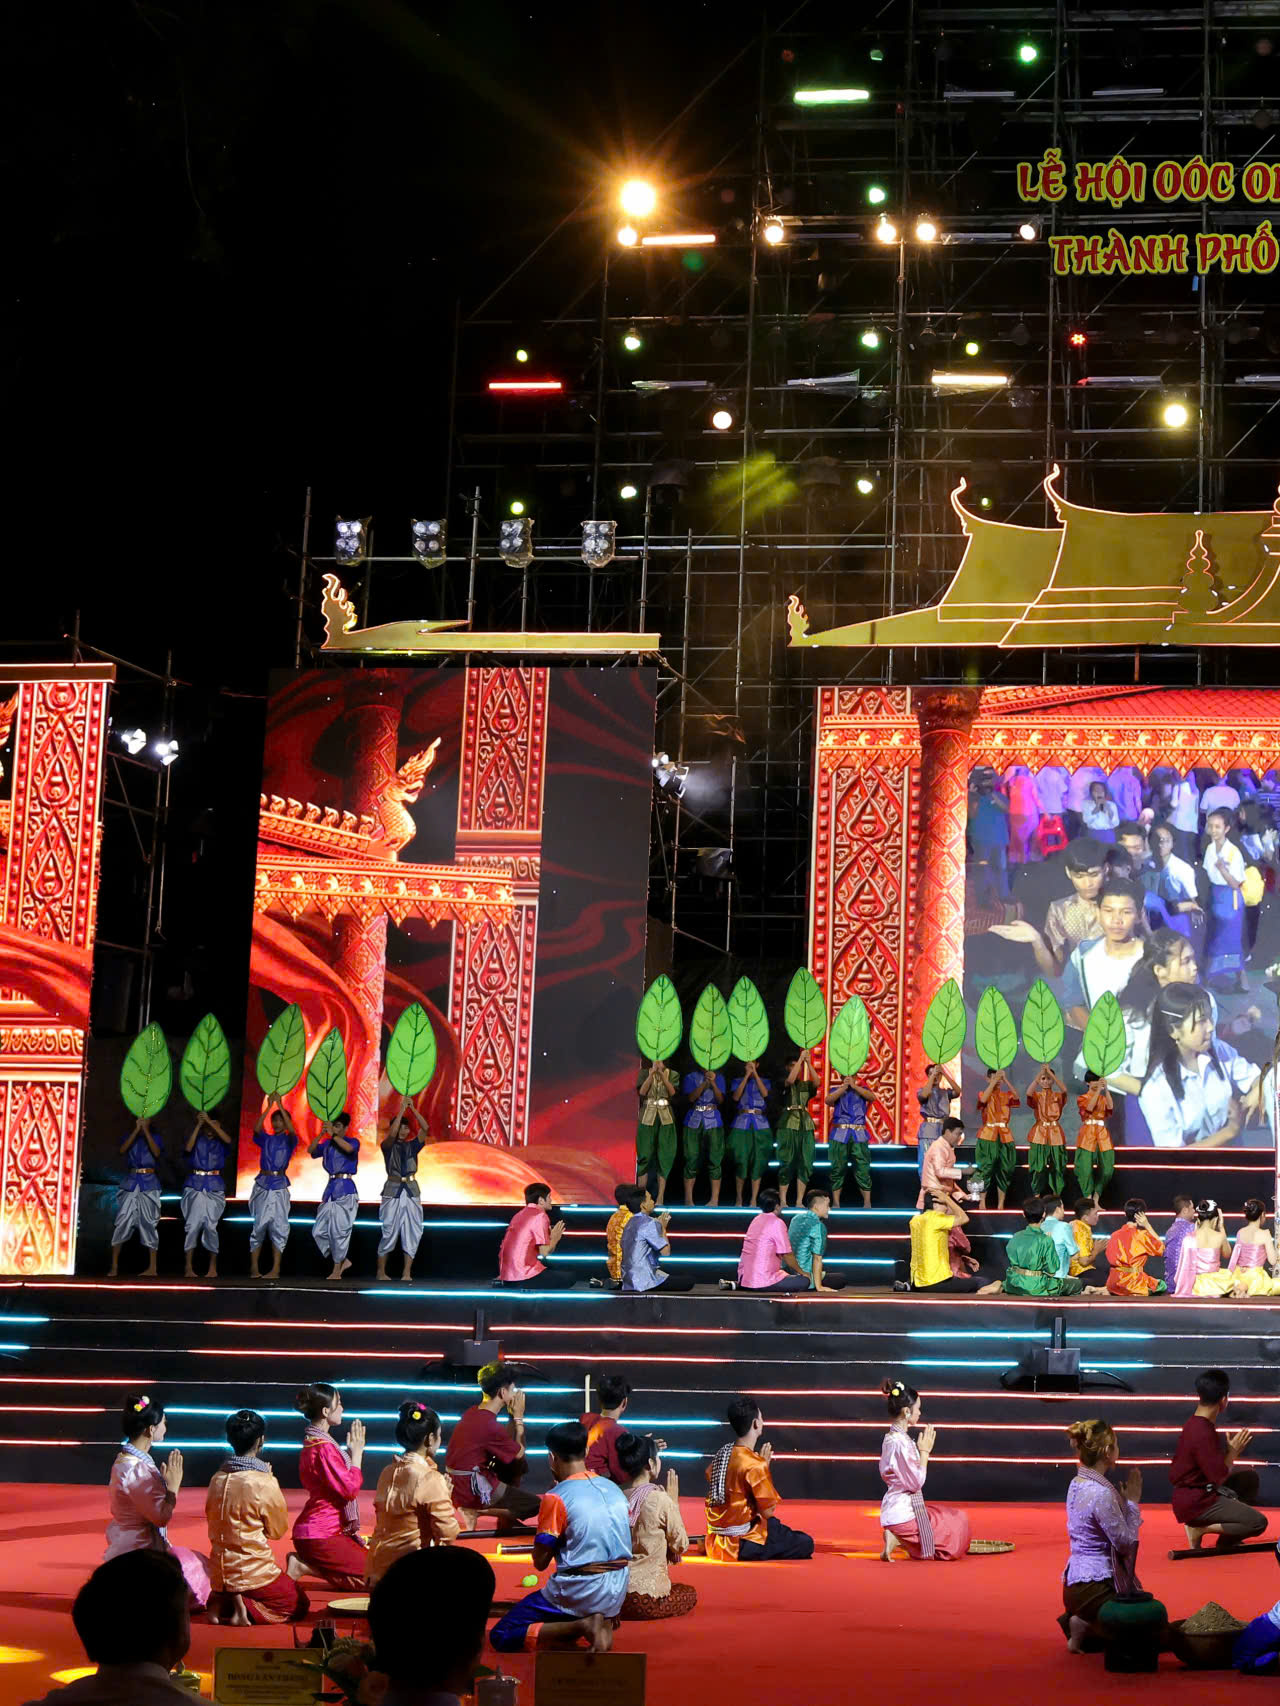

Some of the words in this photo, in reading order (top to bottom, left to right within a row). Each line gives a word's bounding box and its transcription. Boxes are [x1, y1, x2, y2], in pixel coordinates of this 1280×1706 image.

[1017, 148, 1067, 202] LỄ
[1074, 155, 1146, 208] HỘI
[1153, 155, 1235, 202] OÓC
[1049, 228, 1188, 275] THÀNH
[1196, 220, 1279, 275] PHỐ
